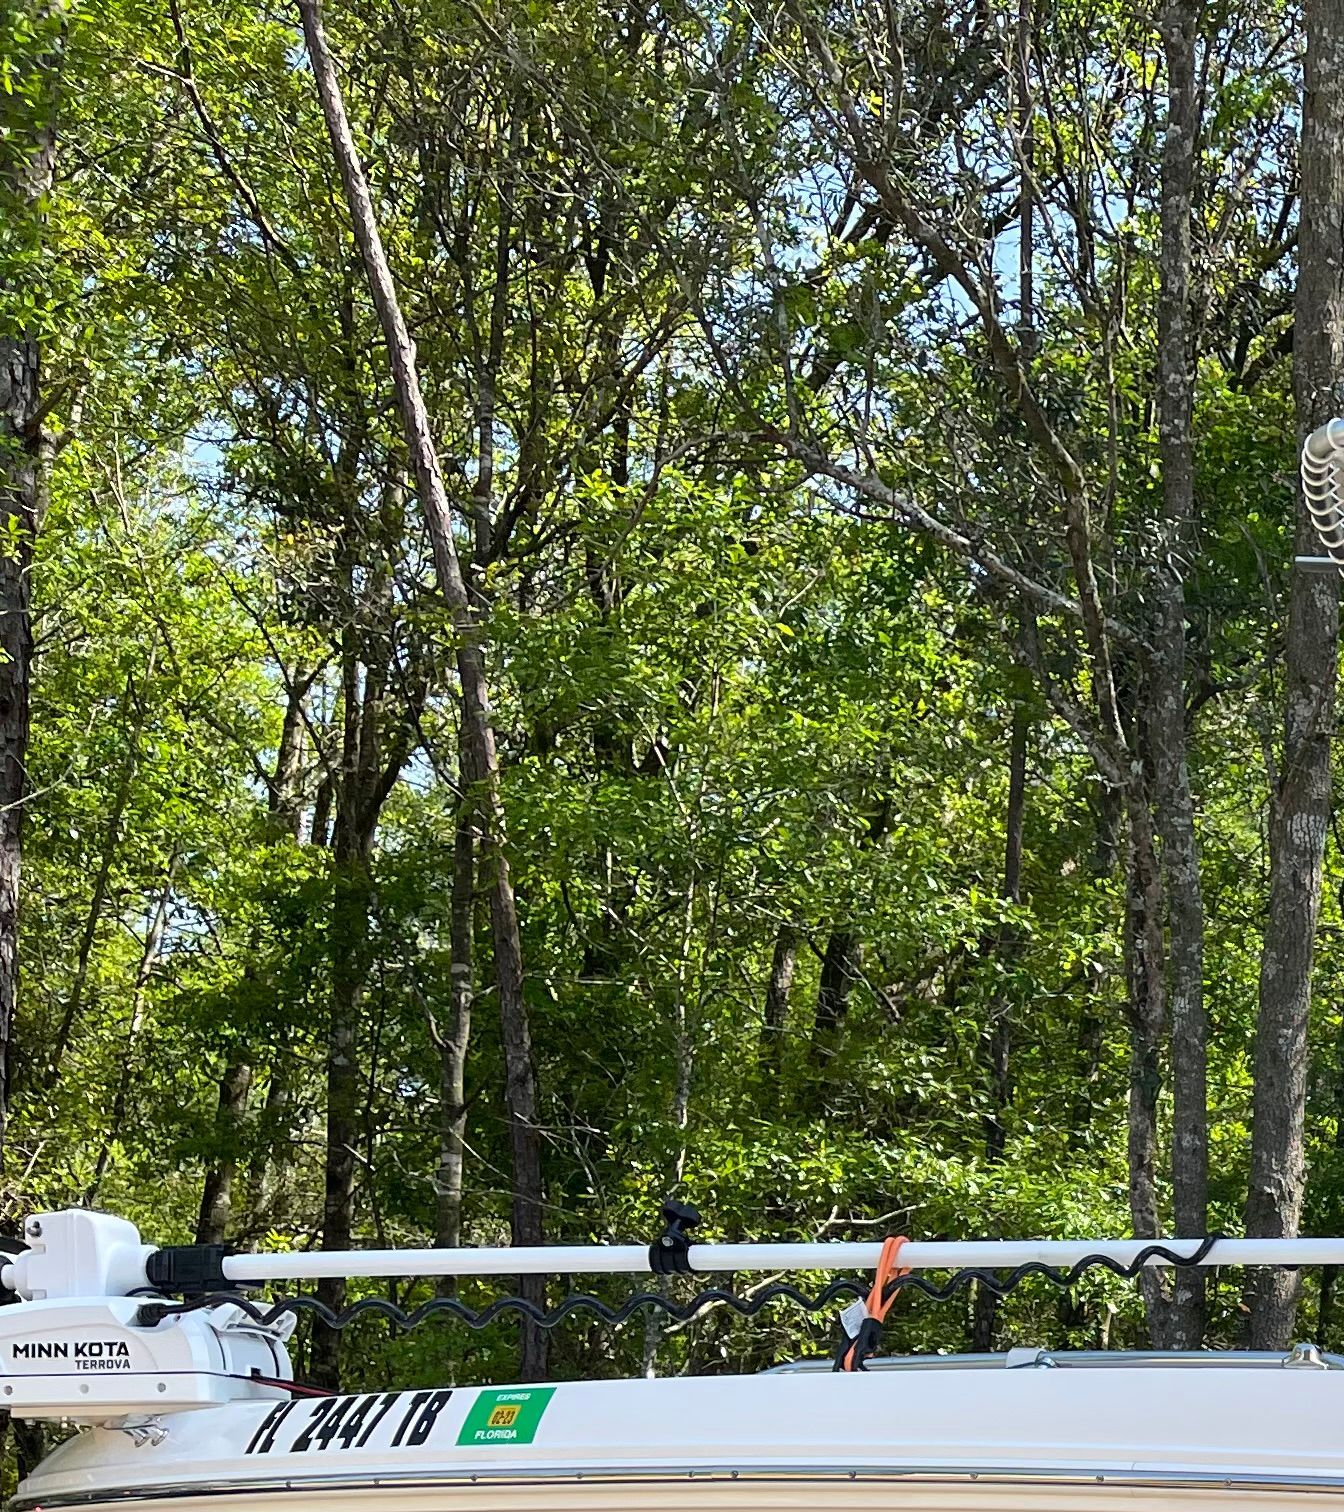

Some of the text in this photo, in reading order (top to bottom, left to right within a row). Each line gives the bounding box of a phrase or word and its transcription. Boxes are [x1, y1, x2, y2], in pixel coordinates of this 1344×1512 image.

[12, 1342, 130, 1359] MINN KOTA
[75, 1359, 131, 1370] TERROVA
[245, 1391, 453, 1454] FL 2447 TB
[474, 1429, 517, 1440] FLORIDA
